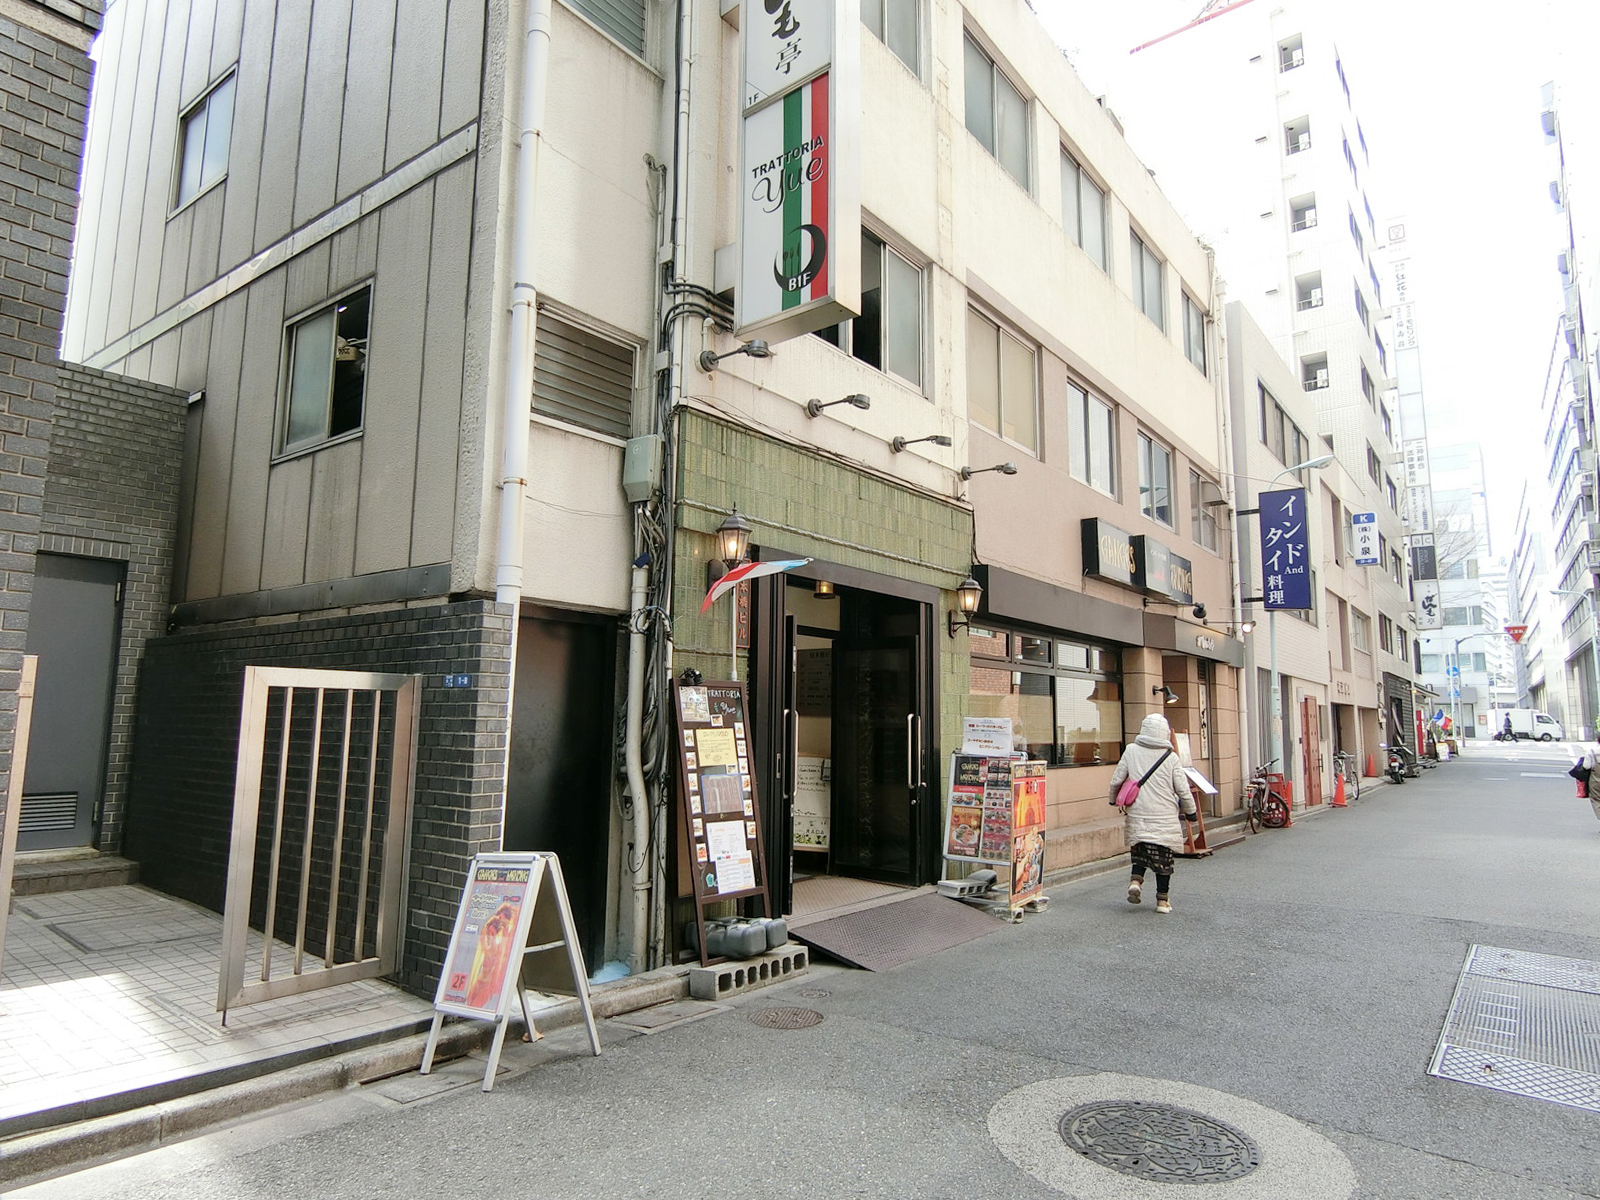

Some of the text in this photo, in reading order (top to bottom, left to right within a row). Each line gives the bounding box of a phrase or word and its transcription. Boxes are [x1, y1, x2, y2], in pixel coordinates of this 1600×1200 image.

[748, 92, 760, 105] 1F
[751, 134, 825, 179] TRATTORIA
[751, 156, 824, 214] Yue
[1279, 494, 1305, 566] インド
[1360, 534, 1372, 556] 小泉
[1265, 527, 1286, 605] タイ料理
[1284, 565, 1304, 575] And
[708, 689, 741, 699] TRATTORIA
[452, 974, 466, 988] 2F
